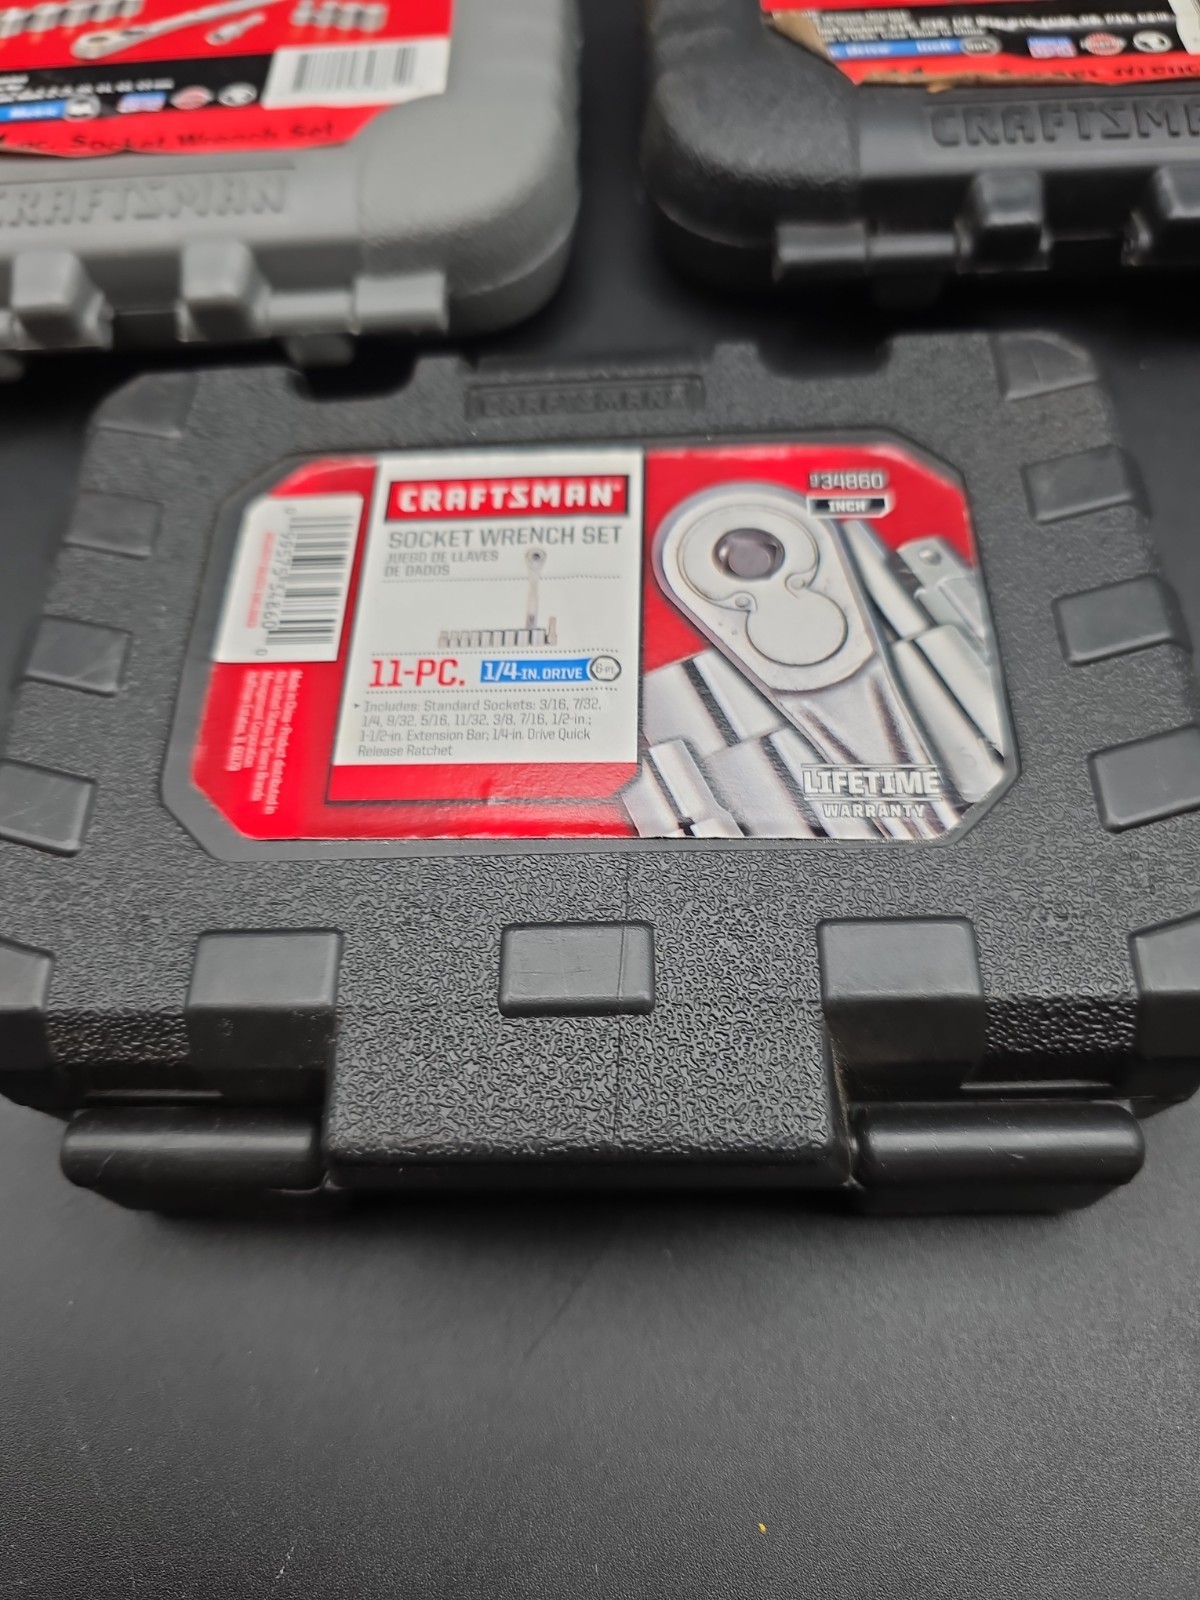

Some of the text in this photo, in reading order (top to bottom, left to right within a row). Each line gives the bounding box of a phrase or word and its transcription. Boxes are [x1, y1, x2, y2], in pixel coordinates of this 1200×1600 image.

[0, 174, 287, 227] RAFTSMAN
[828, 500, 867, 512] INCH
[388, 526, 622, 549] SOCKET WRENCH SET
[386, 550, 499, 565] JUEGO DE LLAVES
[384, 565, 450, 578] DE DADOS
[369, 658, 465, 687] 11-PC.
[482, 661, 540, 681] 1/4-IN.
[542, 667, 583, 680] DRIVE
[364, 697, 602, 712] Includes: Standard Sockets: 3/16, 7/32,
[421, 714, 449, 727] 5/16,
[455, 714, 489, 726] 11/32,
[493, 713, 516, 726] 3/8,
[520, 713, 547, 726] 7/16,
[407, 729, 463, 741] Extension
[466, 728, 489, 740] Bar;
[492, 728, 524, 741] 1/4-in.
[527, 728, 555, 740] Drive
[558, 728, 591, 741] Quick
[358, 744, 453, 757] Release Ratchet
[803, 771, 940, 794] LIFETIME
[823, 803, 925, 818] WARRANTY
